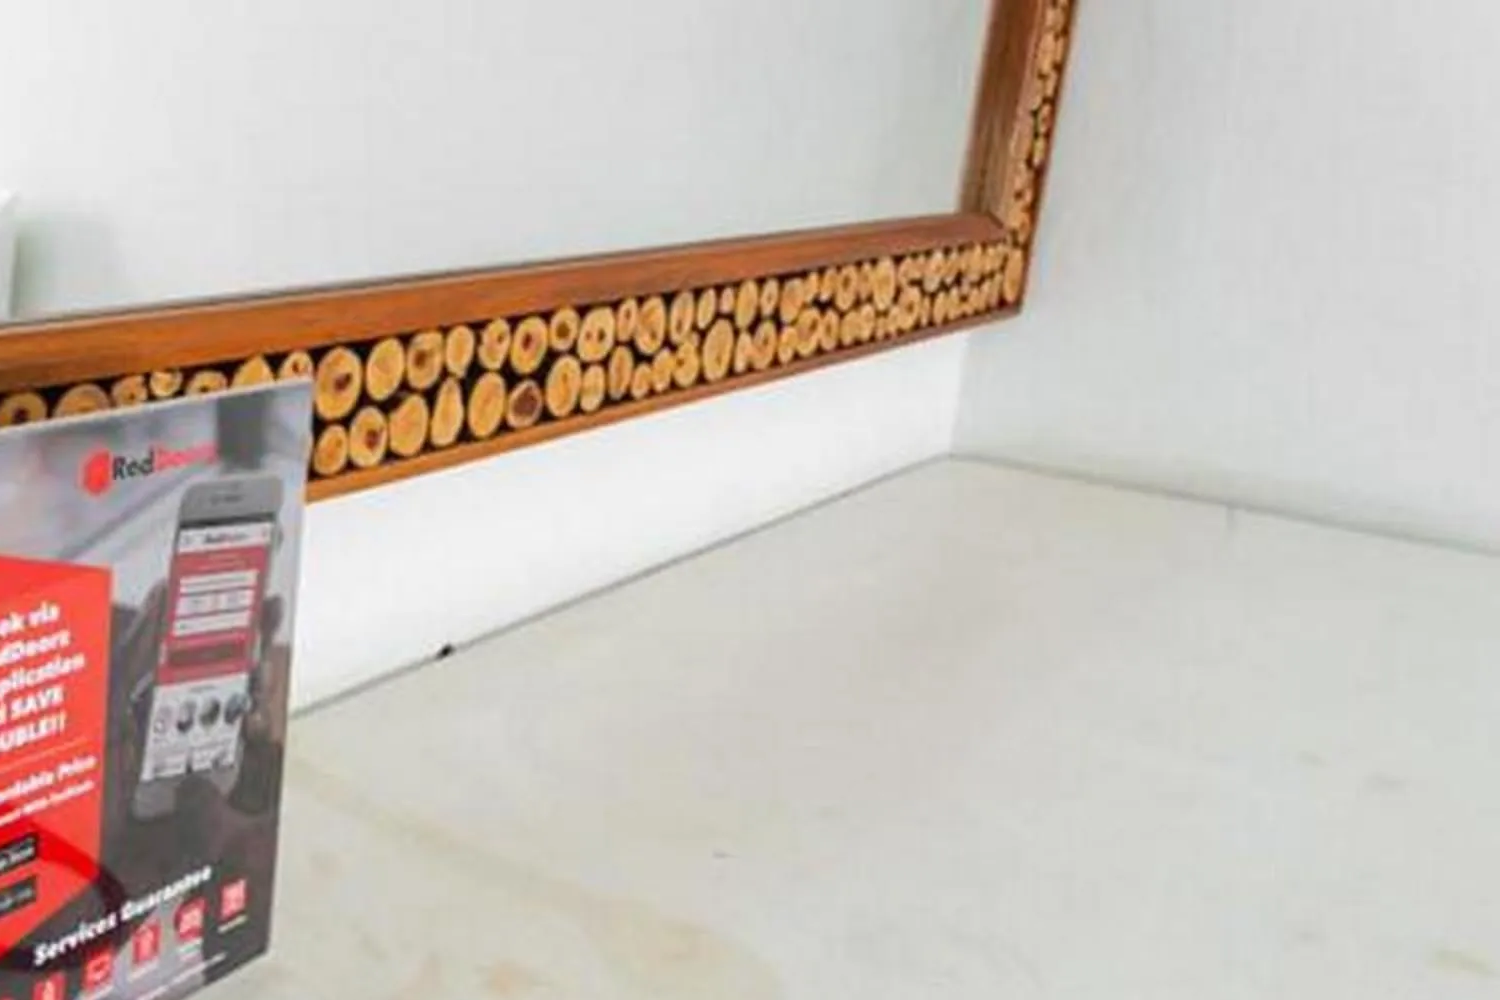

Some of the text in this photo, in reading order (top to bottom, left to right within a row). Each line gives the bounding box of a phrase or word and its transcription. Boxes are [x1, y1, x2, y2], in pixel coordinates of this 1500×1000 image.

[28, 601, 60, 628] via
[10, 684, 64, 720] SAVE
[33, 909, 119, 967] Services
